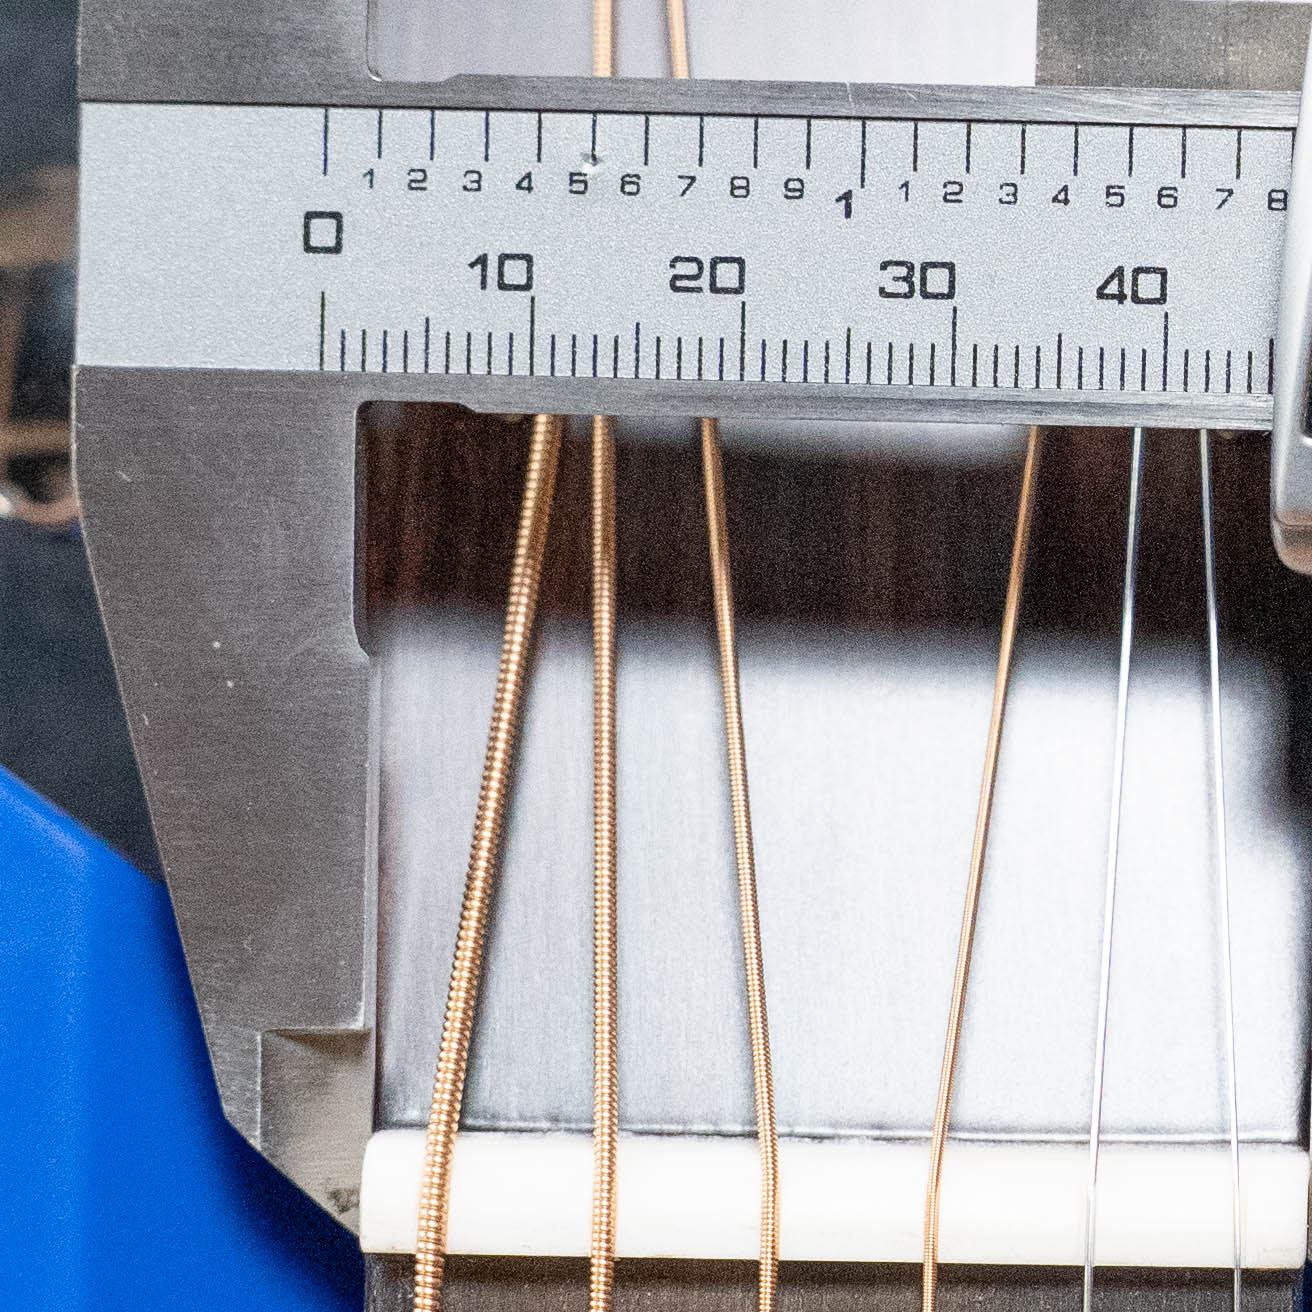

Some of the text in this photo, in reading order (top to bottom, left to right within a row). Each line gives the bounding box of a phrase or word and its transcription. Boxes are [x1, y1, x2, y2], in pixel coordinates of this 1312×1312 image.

[362, 167, 1290, 220] 1 2 3 4 5 6 7 8 9 1 1 2 3 4 5 6 7 8
[302, 209, 345, 255] 0
[467, 251, 1169, 306] 10 20 30 40
